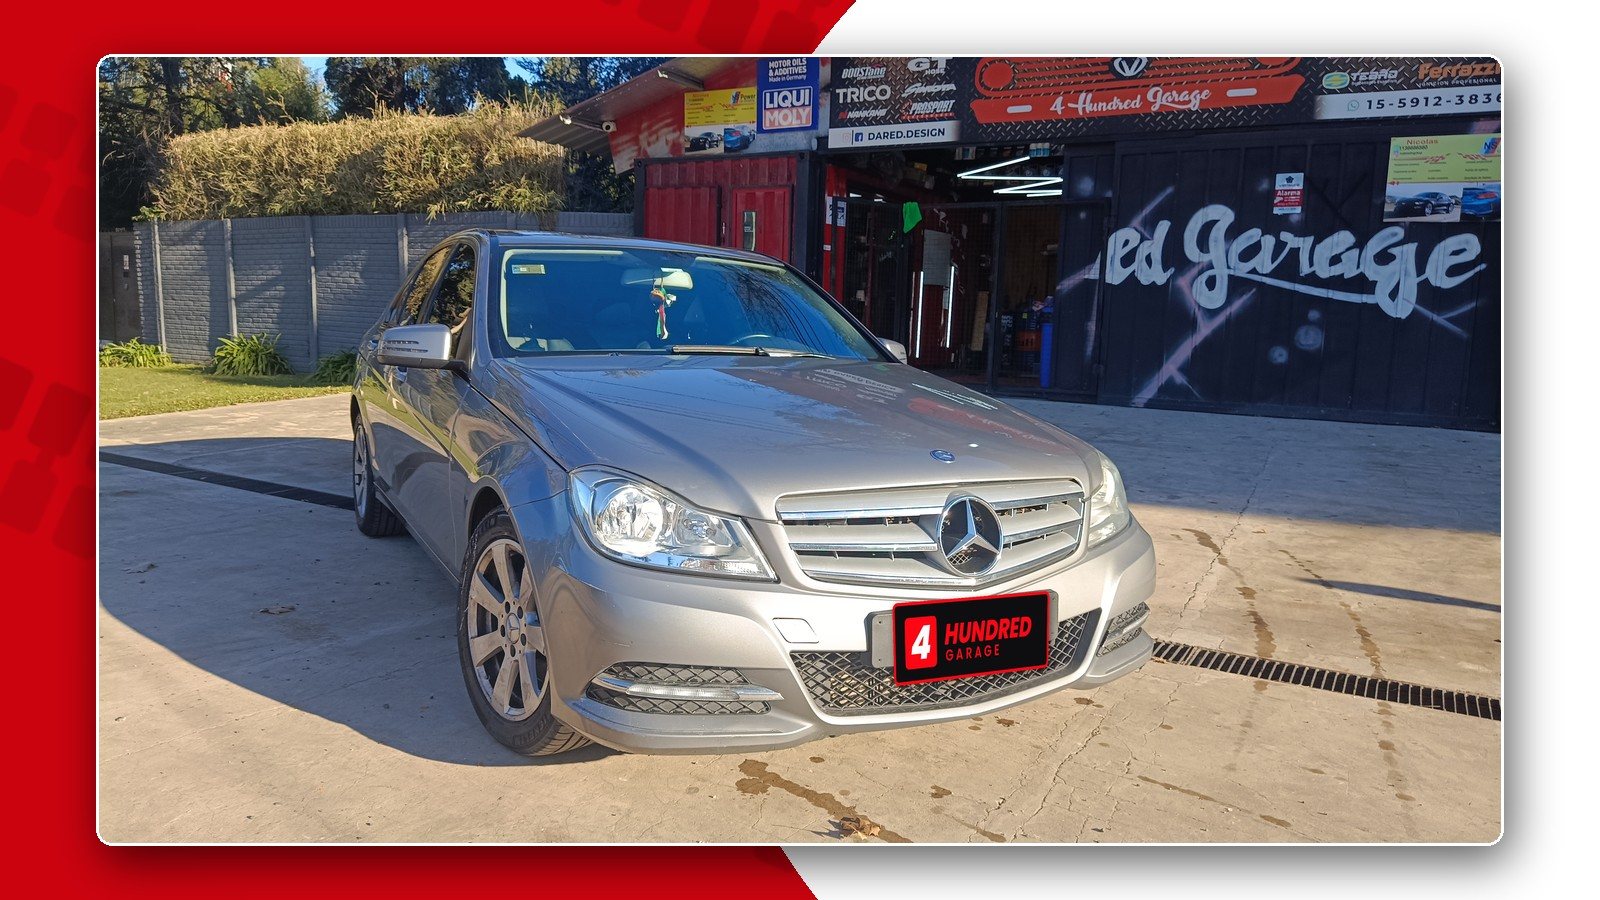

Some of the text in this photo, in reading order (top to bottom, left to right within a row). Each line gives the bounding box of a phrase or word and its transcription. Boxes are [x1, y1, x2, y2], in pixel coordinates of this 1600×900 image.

[768, 58, 807, 69] MOTOR OILS
[774, 65, 807, 76] ADDITIVES
[765, 88, 810, 109] LIQUI
[835, 84, 891, 103] TRICO
[1049, 86, 1212, 115] 4 Hundred Garage
[909, 99, 956, 114] PROSPORT
[765, 108, 811, 127] MOLY
[868, 128, 945, 141] DARED.DESIGN
[1406, 138, 1438, 146] Nicolas
[1183, 204, 1487, 319] Garage
